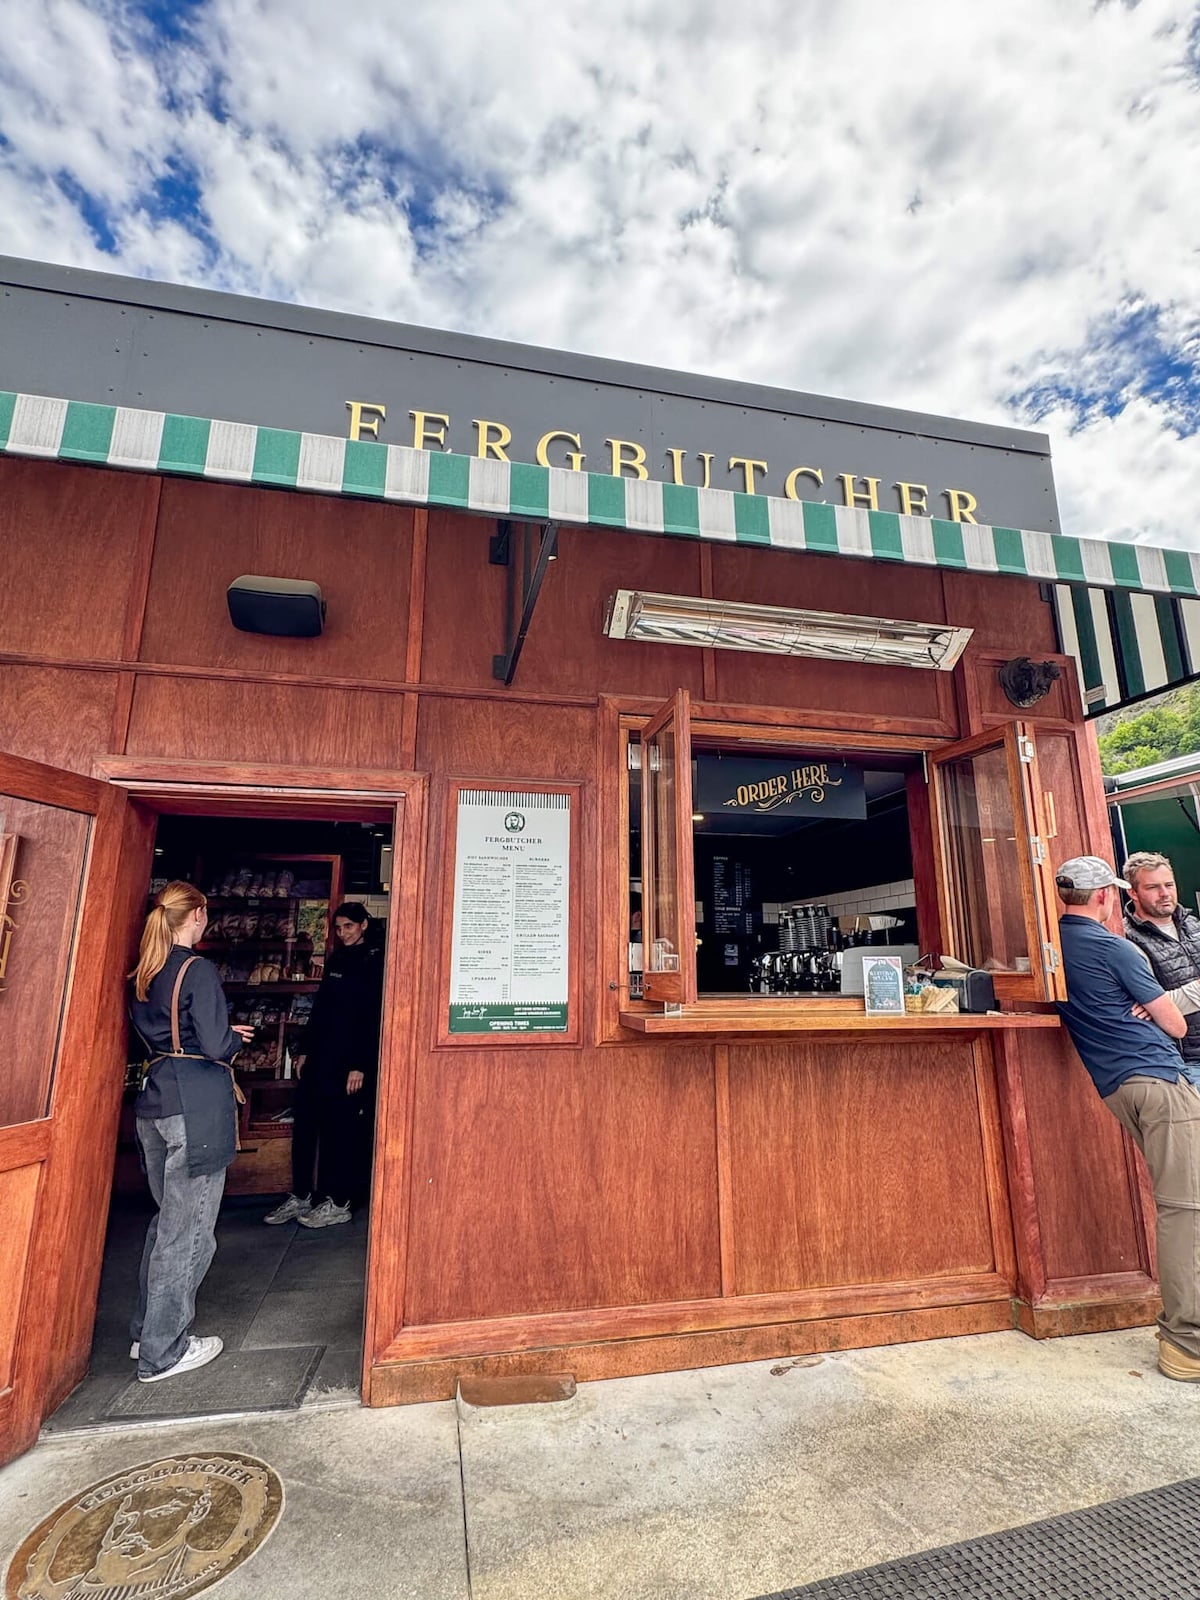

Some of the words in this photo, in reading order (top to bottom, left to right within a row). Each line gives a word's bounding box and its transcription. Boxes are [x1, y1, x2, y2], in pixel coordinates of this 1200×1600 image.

[345, 400, 980, 525] FERGBUTCHER
[736, 775, 788, 806] ORDER
[791, 763, 842, 790] HERE
[484, 836, 543, 845] FERGBUTCHER
[77, 1463, 255, 1512] FERGBUTCHER
